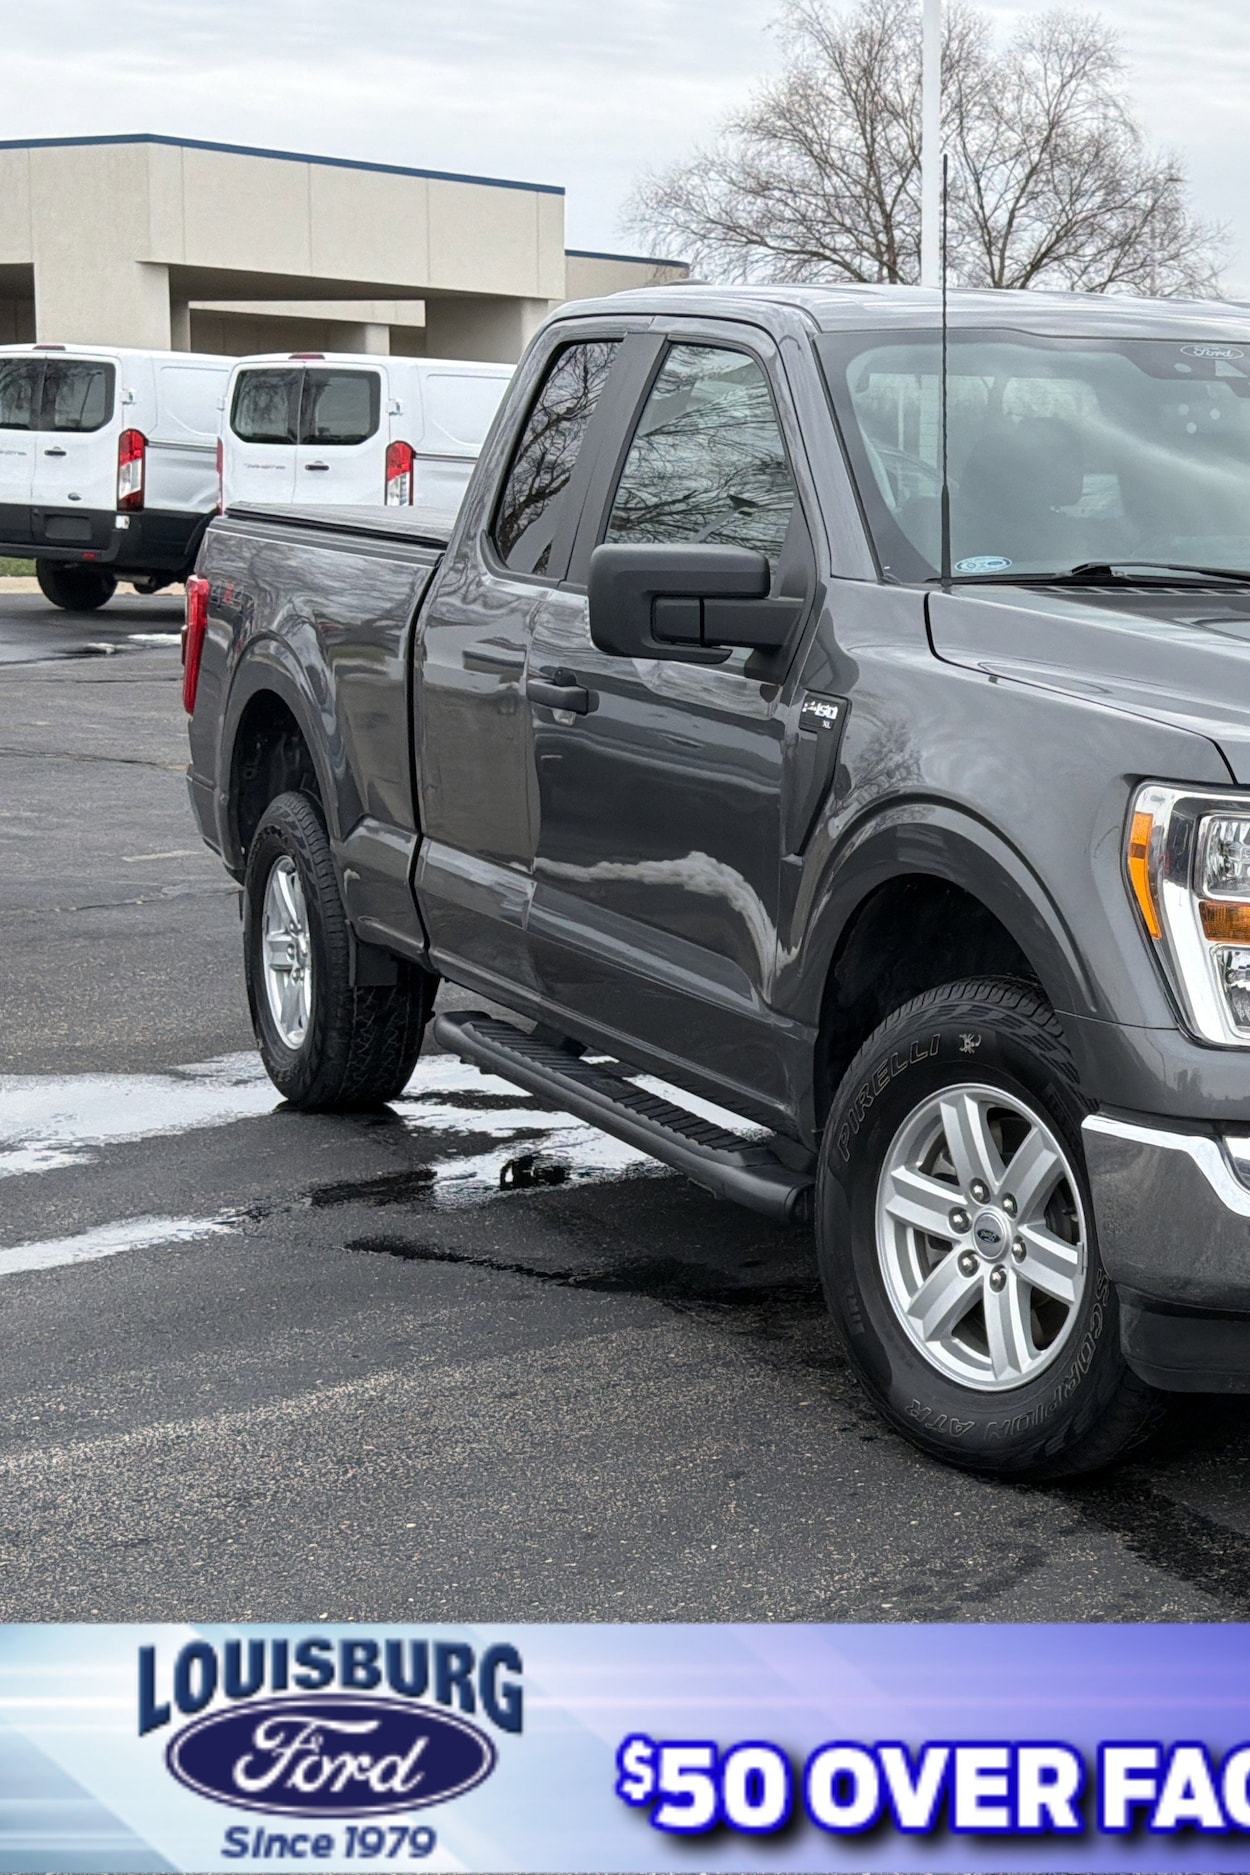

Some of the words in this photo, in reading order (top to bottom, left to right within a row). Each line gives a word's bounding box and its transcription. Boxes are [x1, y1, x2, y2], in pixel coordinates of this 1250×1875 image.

[1193, 345, 1234, 358] Ford
[837, 1033, 942, 1163] PIRELLI
[984, 1268, 1110, 1440] SCORPION
[904, 1398, 976, 1438] ATR
